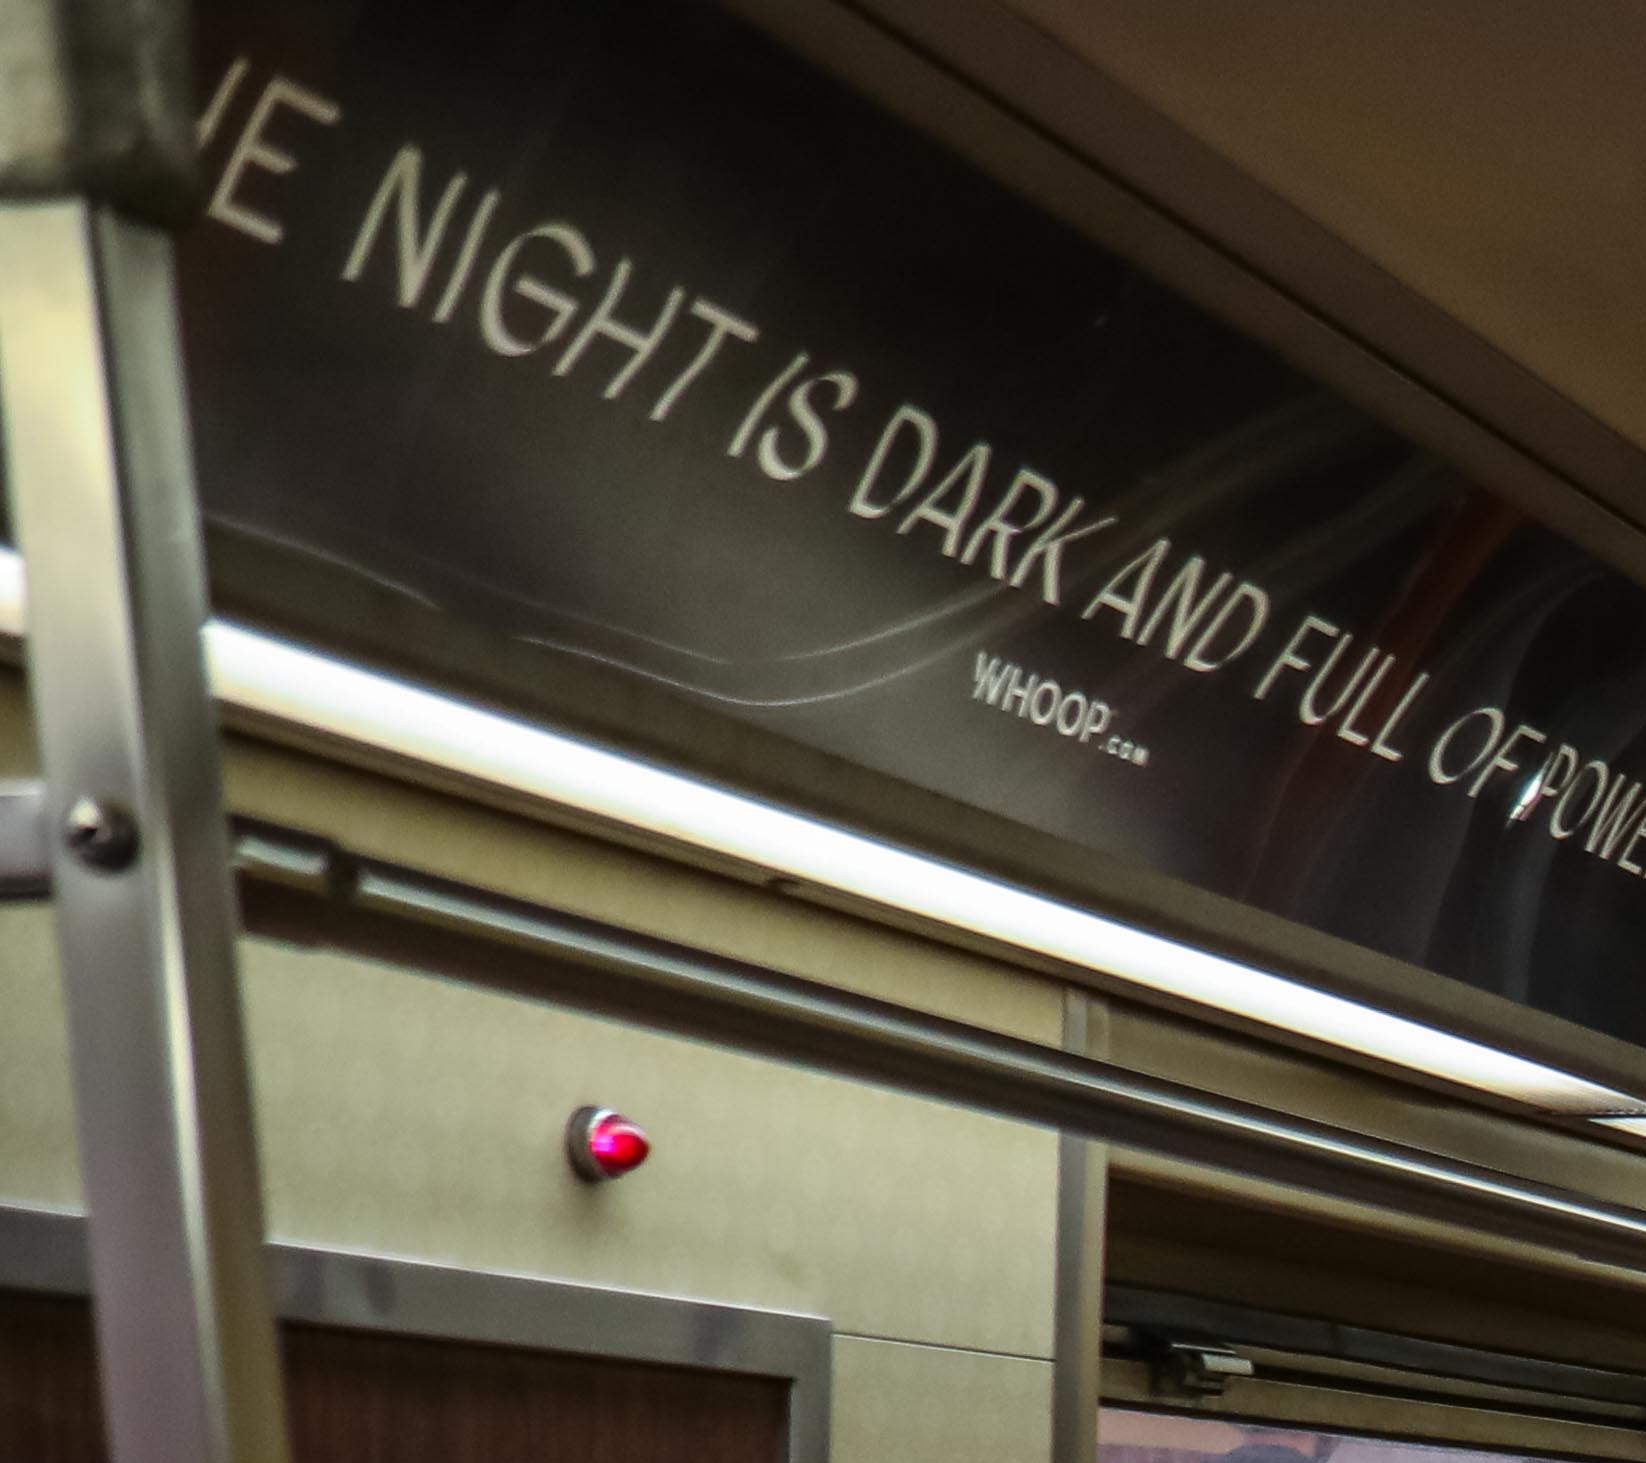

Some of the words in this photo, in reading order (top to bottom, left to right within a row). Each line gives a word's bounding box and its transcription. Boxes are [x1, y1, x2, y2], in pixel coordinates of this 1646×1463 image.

[342, 143, 759, 423] NIGHT
[727, 352, 858, 481] IS
[850, 404, 1116, 605] DARK
[1083, 538, 1269, 673] AND
[1253, 614, 1430, 764] FULL
[1428, 707, 1547, 798] OF
